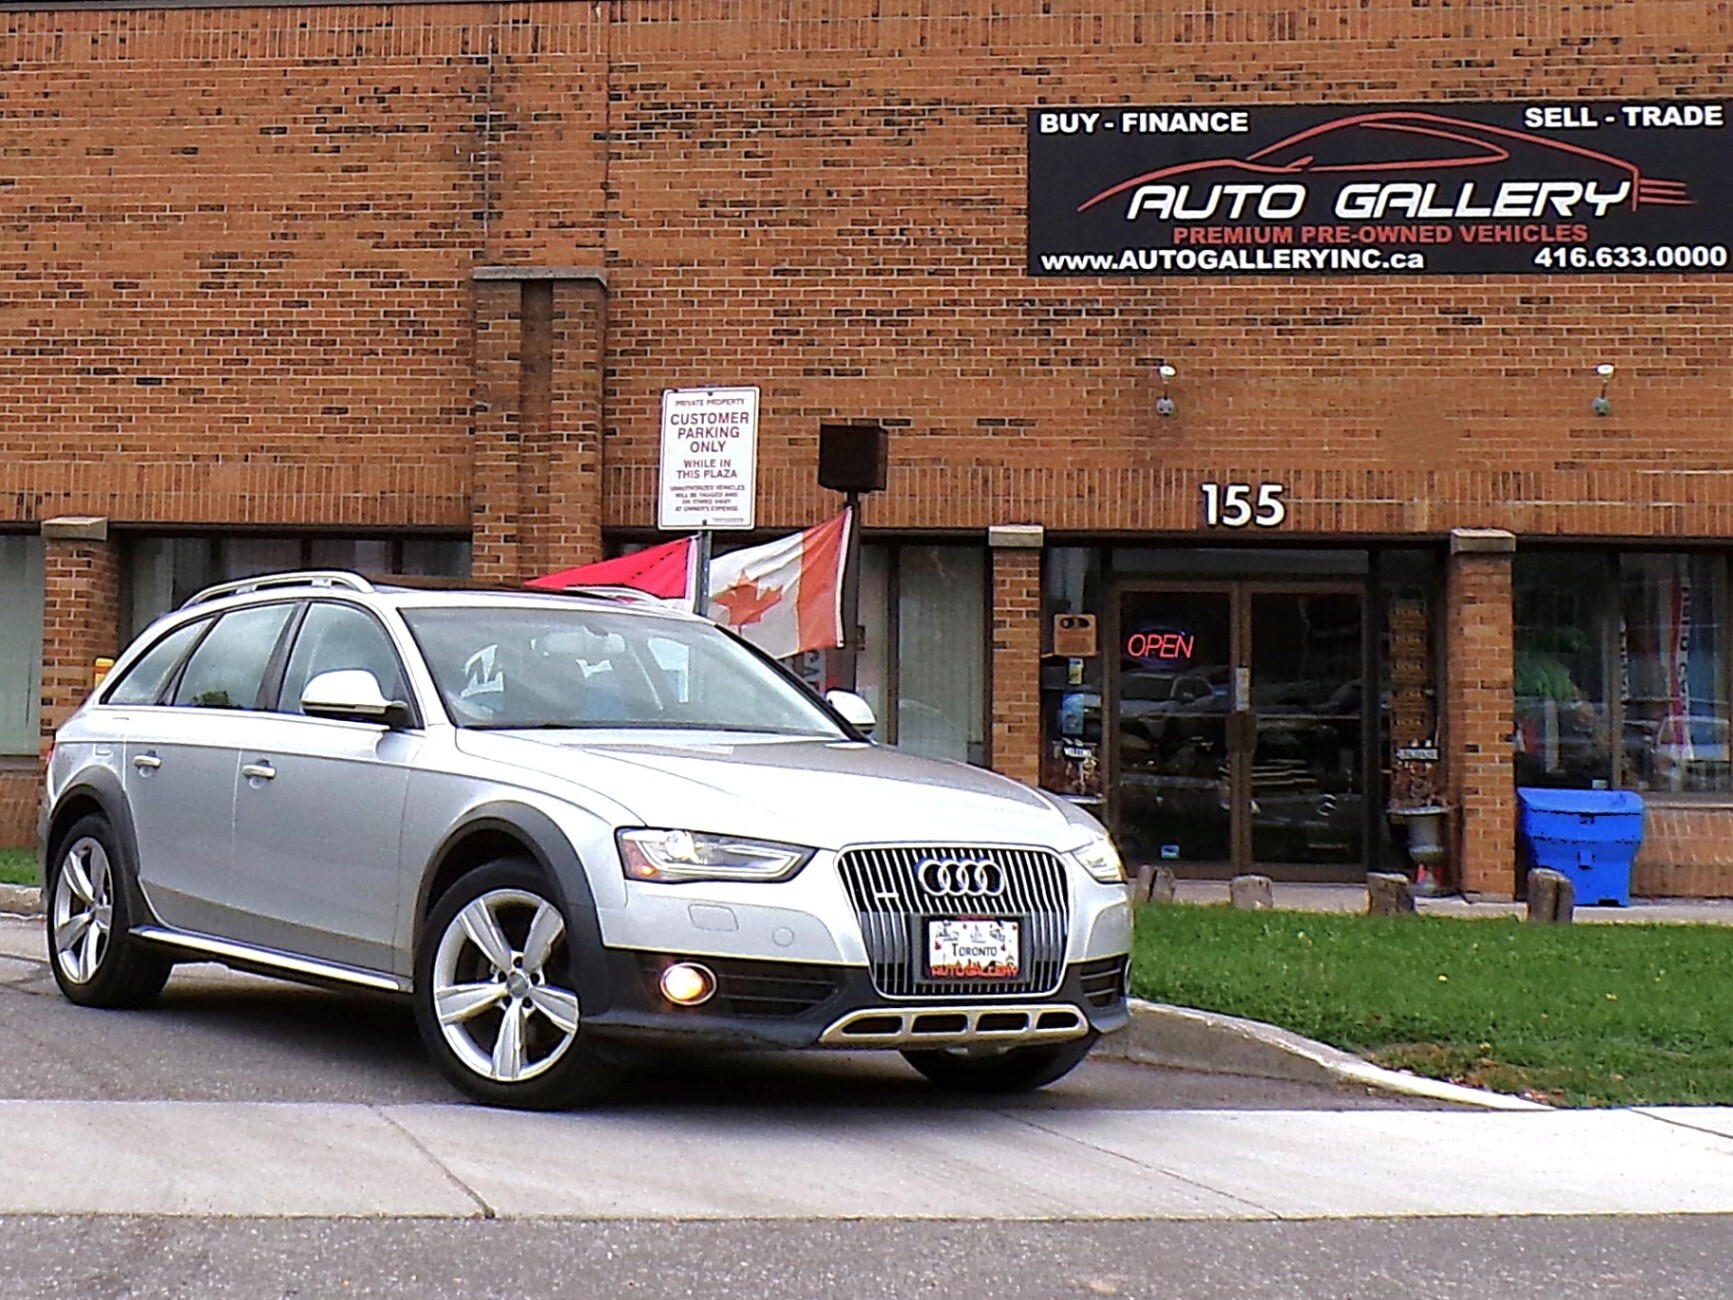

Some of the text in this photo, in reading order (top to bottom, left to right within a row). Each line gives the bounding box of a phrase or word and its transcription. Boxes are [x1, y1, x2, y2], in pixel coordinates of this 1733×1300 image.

[1040, 113, 1100, 133] BUY
[1122, 112, 1249, 132] FINANCE
[1524, 106, 1599, 128] SELL
[1621, 105, 1724, 127] TRADE
[1126, 181, 1631, 219] AUTO GALLERY
[1173, 224, 1589, 245] PREMIUM PRE-OWNED VEHICLES
[1041, 248, 1425, 270] www.AUTOGALLERYINC.ca
[1534, 246, 1728, 268] 416.633.0000
[670, 411, 749, 426] CUSTOMER
[677, 426, 740, 440] PARKING
[690, 440, 727, 453] ONLY
[676, 468, 738, 480] THIS PLAZA
[683, 458, 732, 469] WHILE IN
[1201, 483, 1286, 527] 155
[1127, 633, 1194, 659] OPEN
